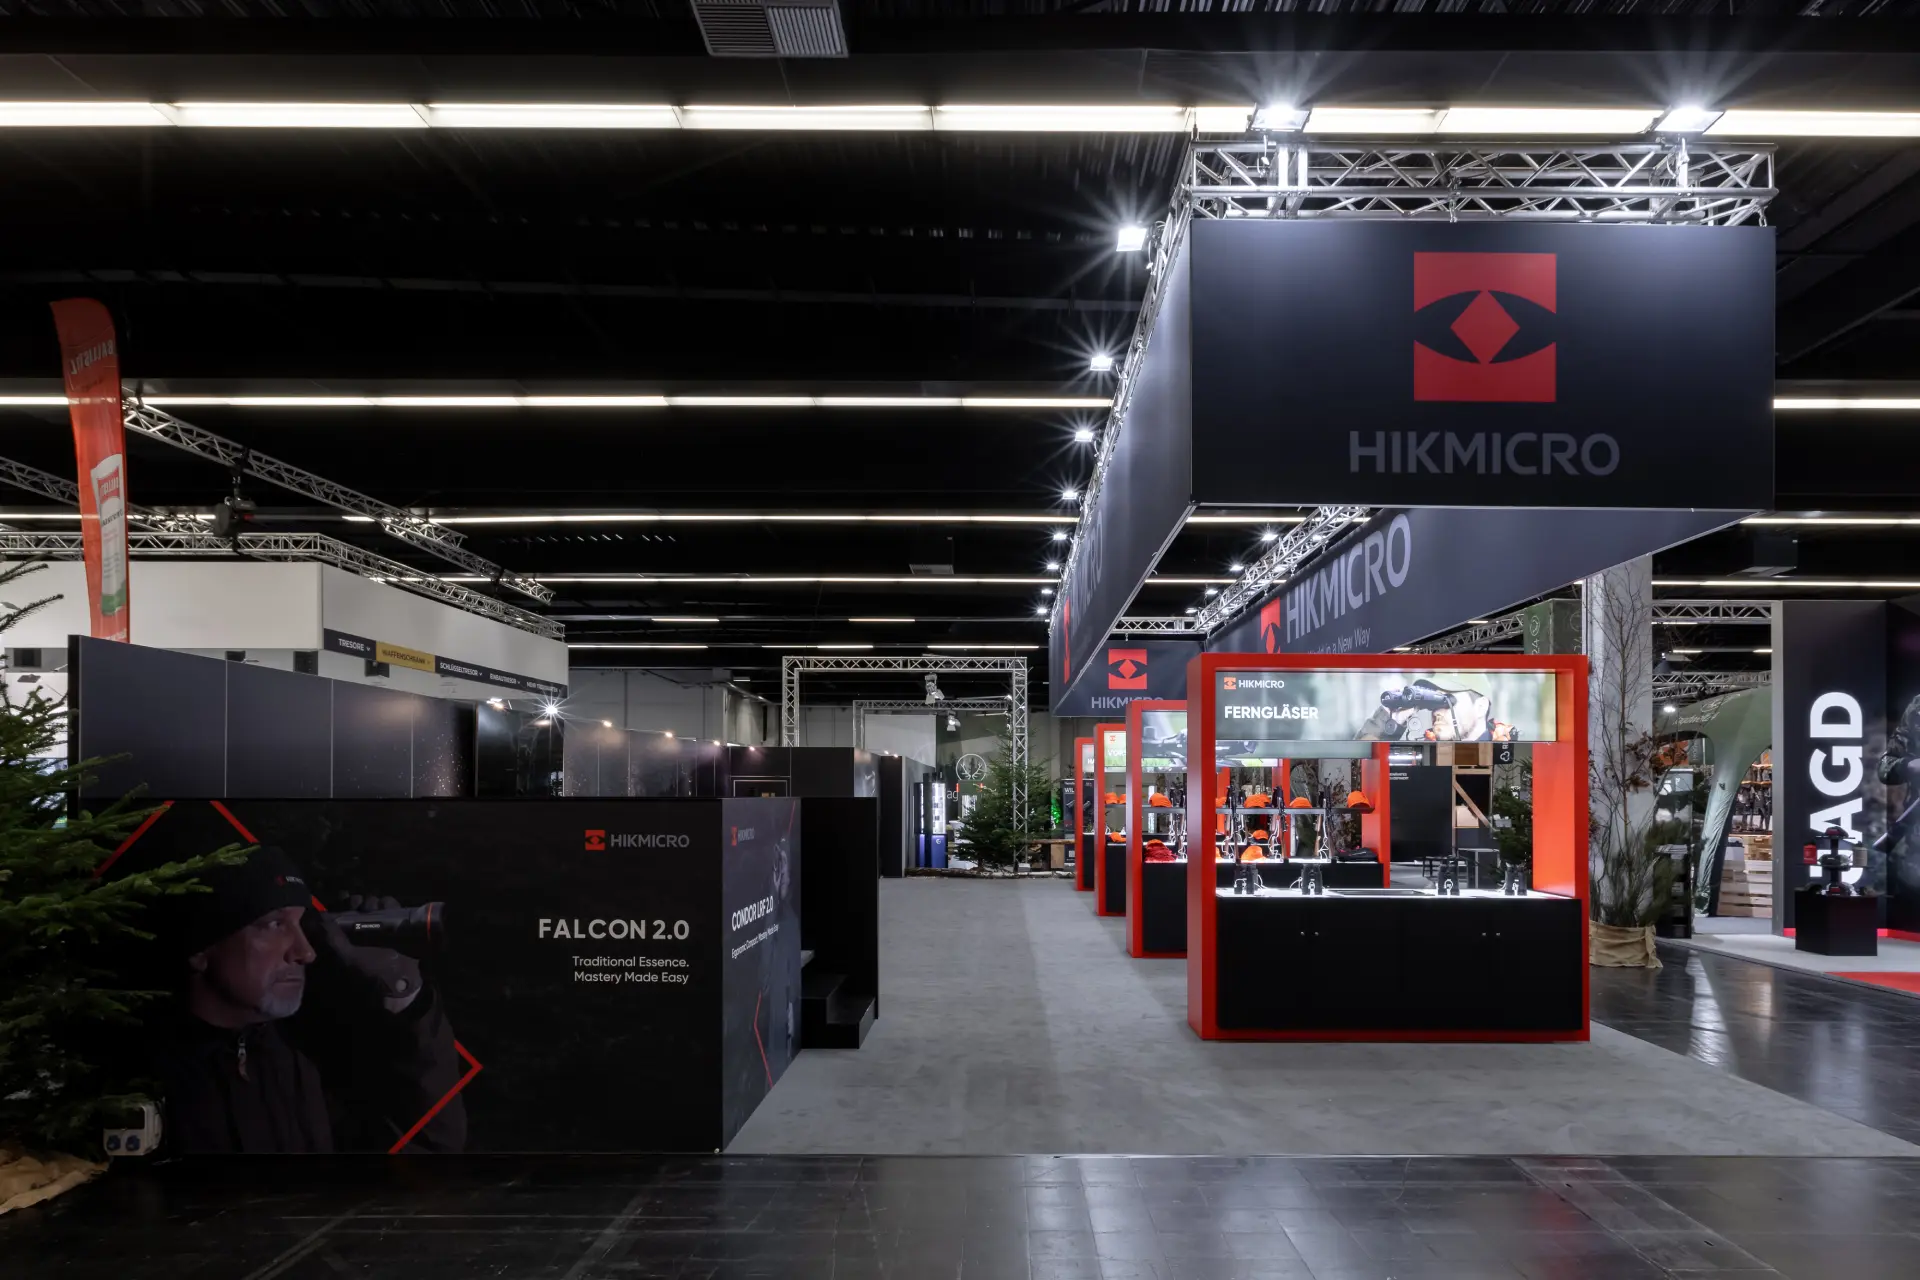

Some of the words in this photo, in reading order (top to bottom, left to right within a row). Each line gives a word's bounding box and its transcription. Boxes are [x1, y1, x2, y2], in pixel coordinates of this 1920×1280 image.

[1349, 430, 1620, 476] HIKMICRO
[1286, 513, 1411, 644] HIKMICRO
[338, 638, 365, 651] TRESORE
[1337, 635, 1353, 654] New
[1354, 626, 1371, 648] Way
[381, 649, 426, 664] WAFFENSCHRANK
[439, 662, 479, 677] SCHLÜSSELTRESOR
[1238, 679, 1285, 689] HIKMICRO
[1091, 696, 1164, 709] HIKM
[1224, 703, 1319, 719] FERNGLÄSER
[609, 834, 690, 848] HIKMICRO
[731, 903, 757, 932] CONDOR
[757, 898, 766, 919] LRF
[766, 895, 774, 914] 2.0
[538, 918, 646, 940] FALCON
[652, 919, 690, 940] 2.0
[572, 955, 636, 968] Traditional
[639, 956, 690, 968] Essence.
[574, 971, 622, 985] Mastery
[625, 972, 659, 983] Made
[661, 972, 690, 986] Easy
